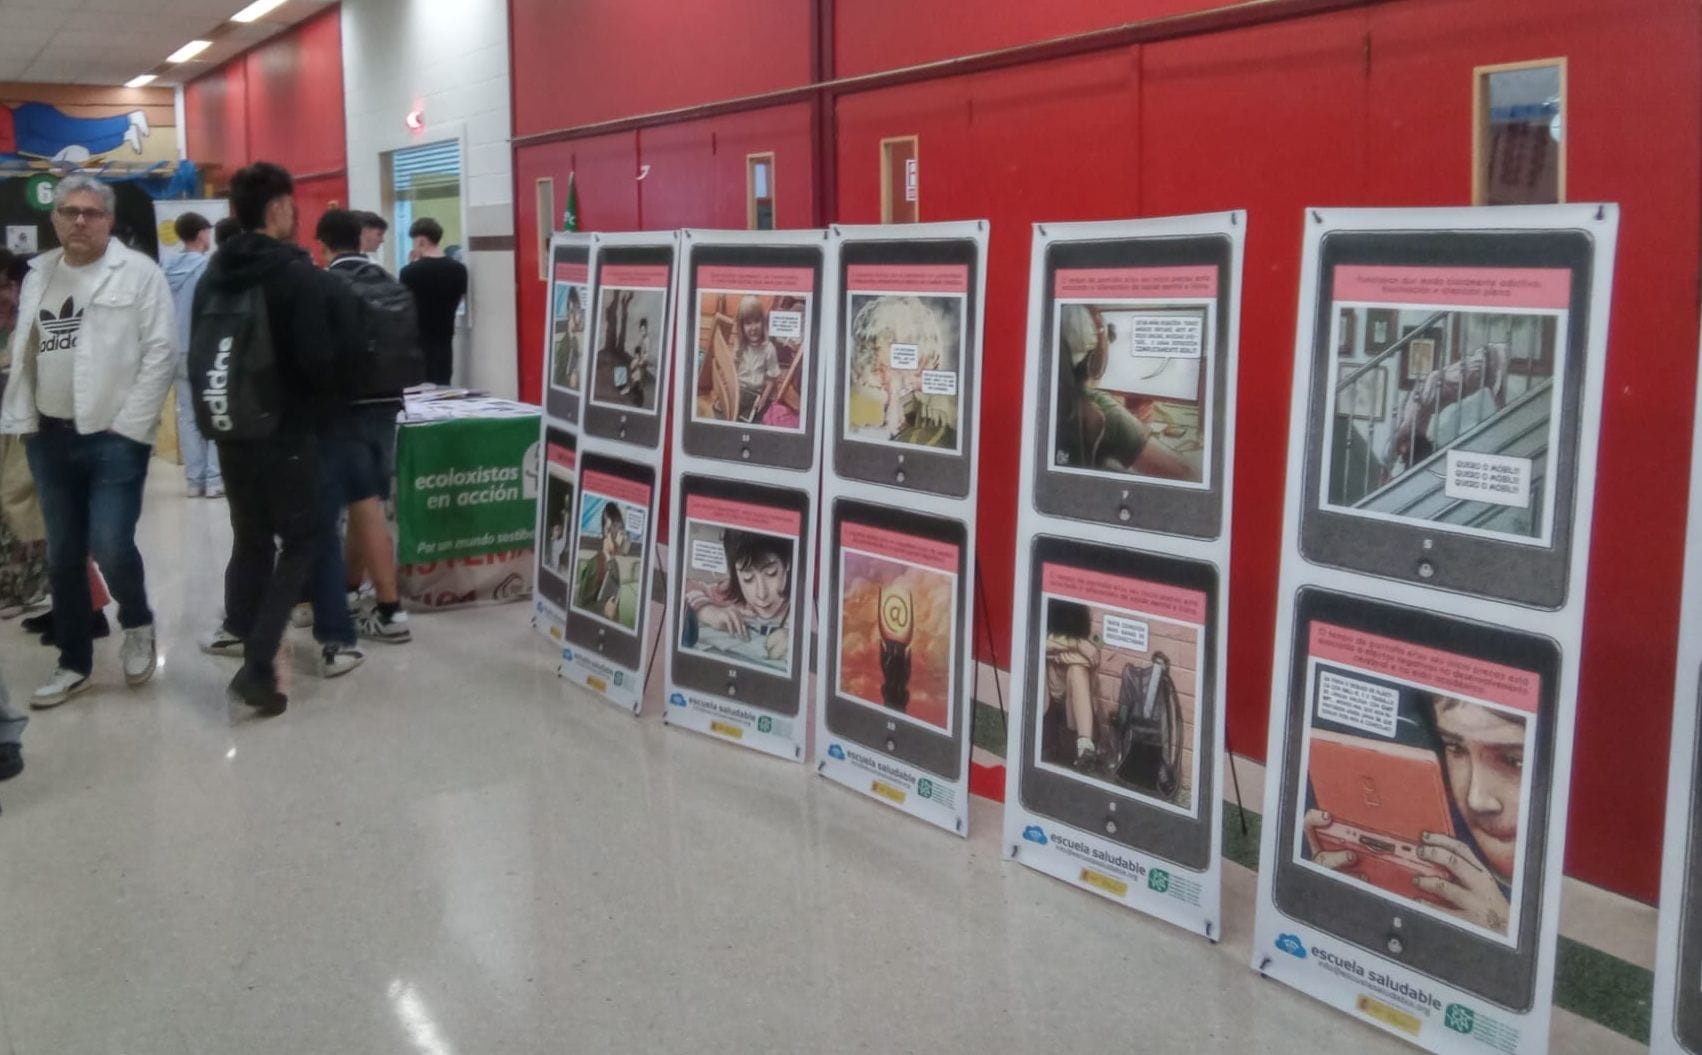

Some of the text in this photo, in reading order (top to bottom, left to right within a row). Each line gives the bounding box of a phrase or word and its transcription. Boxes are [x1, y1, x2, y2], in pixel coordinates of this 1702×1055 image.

[37, 181, 53, 204] 6
[415, 465, 519, 490] ecoloxistas
[427, 483, 518, 509] en acción
[1050, 832, 1146, 876] escuela saludable
[1311, 945, 1442, 1012] escuela saludable
